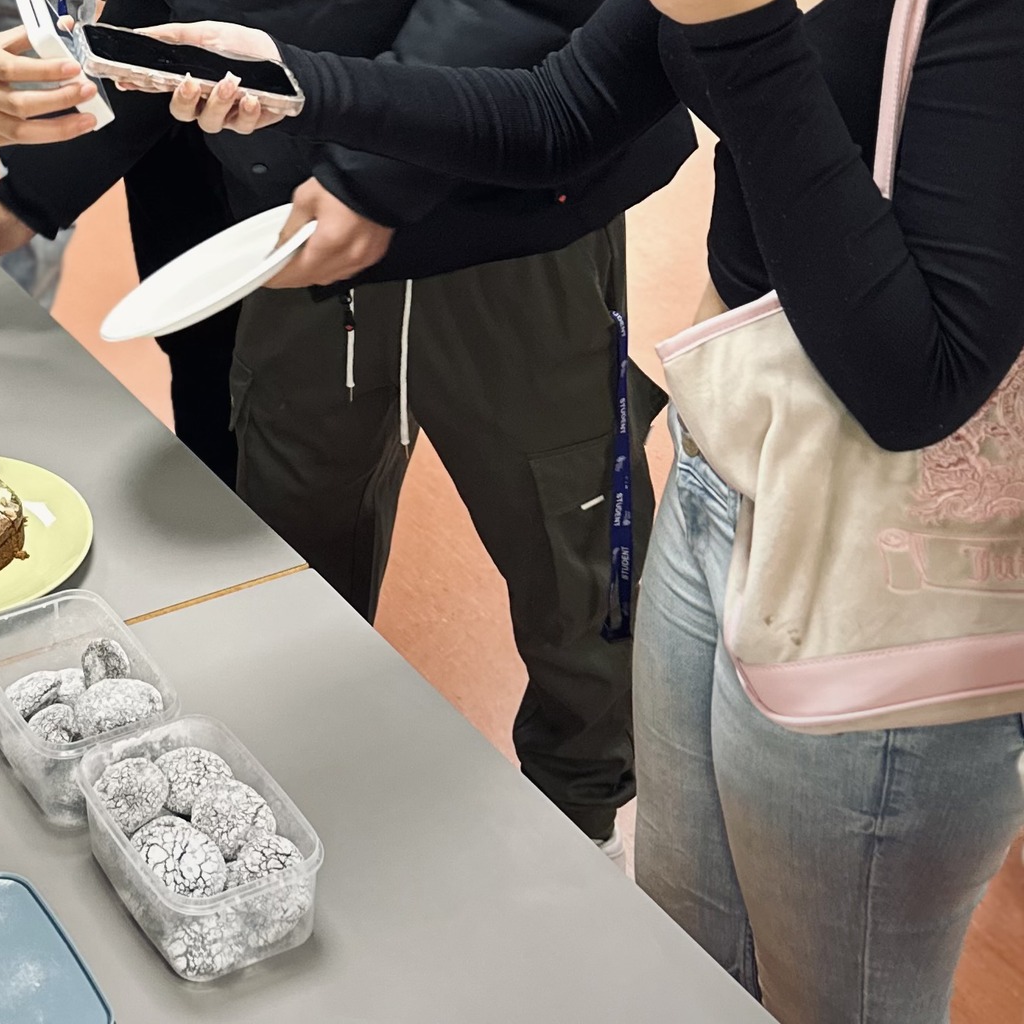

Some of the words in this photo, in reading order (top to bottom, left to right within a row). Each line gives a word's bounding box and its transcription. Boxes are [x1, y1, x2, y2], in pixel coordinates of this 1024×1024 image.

[612, 310, 626, 337] UDENT
[614, 492, 624, 527] STUDENT
[622, 546, 630, 580] STUDENT
